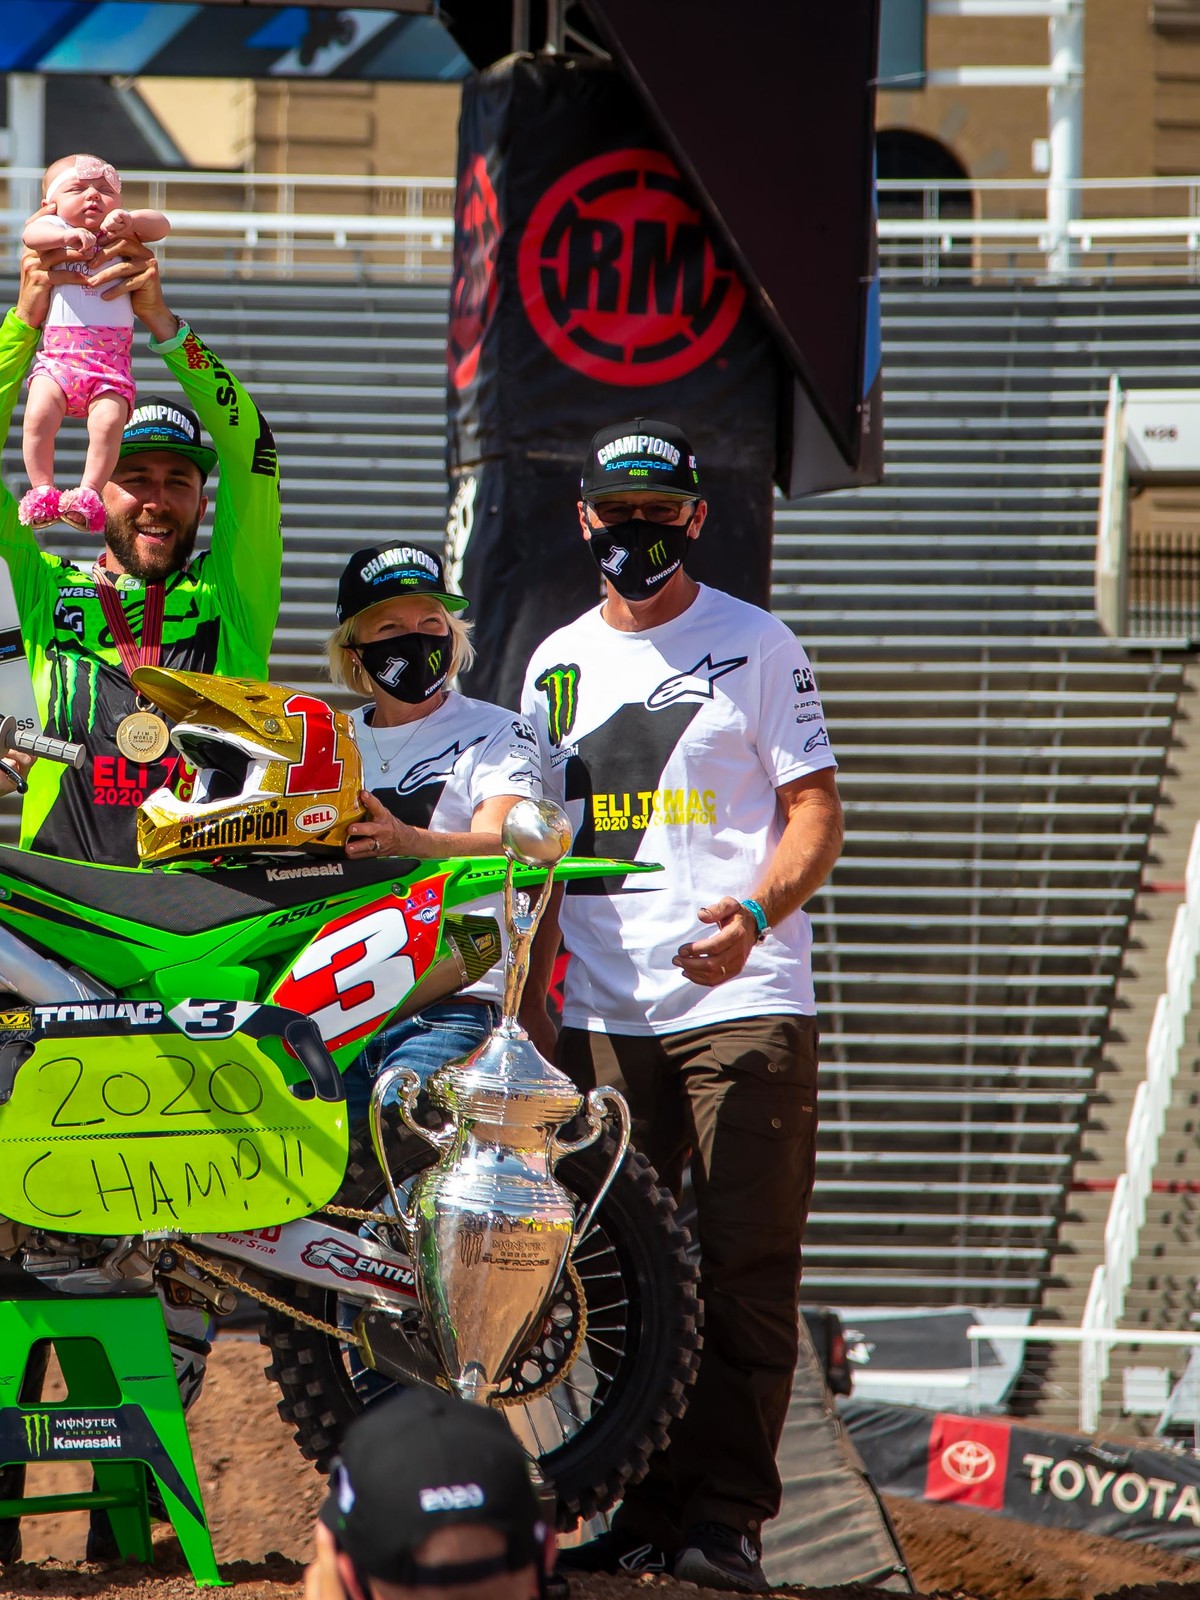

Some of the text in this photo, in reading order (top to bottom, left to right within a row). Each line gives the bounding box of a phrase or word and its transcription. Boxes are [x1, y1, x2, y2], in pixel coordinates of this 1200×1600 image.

[560, 218, 708, 317] RM
[597, 435, 681, 467] CHAMPIONS
[605, 460, 675, 472] SUPERCROSS
[629, 469, 649, 477] 450SX
[360, 547, 439, 584] CHAMPIONS
[600, 545, 630, 576] 1
[376, 656, 409, 688] 1
[283, 694, 344, 797] 1
[94, 756, 147, 788] ELI
[94, 788, 145, 806] 2020
[593, 788, 717, 819] ELI TOMAC
[179, 807, 288, 849] CHAMPION
[303, 810, 332, 826] BELL
[594, 817, 629, 832] 2020
[632, 815, 650, 830] SX
[266, 863, 344, 882] Kawasaki
[267, 900, 327, 929] 450
[291, 907, 417, 1042] 3
[34, 998, 236, 1035] TOMAC 3
[39, 1054, 263, 1127] 2020
[481, 1256, 550, 1267] SUPERCROSS
[56, 1418, 117, 1429] MONSTER
[53, 1436, 122, 1450] Kawasaki
[419, 1482, 485, 1512] 2020
[1022, 1453, 1200, 1528] TOYOTA
